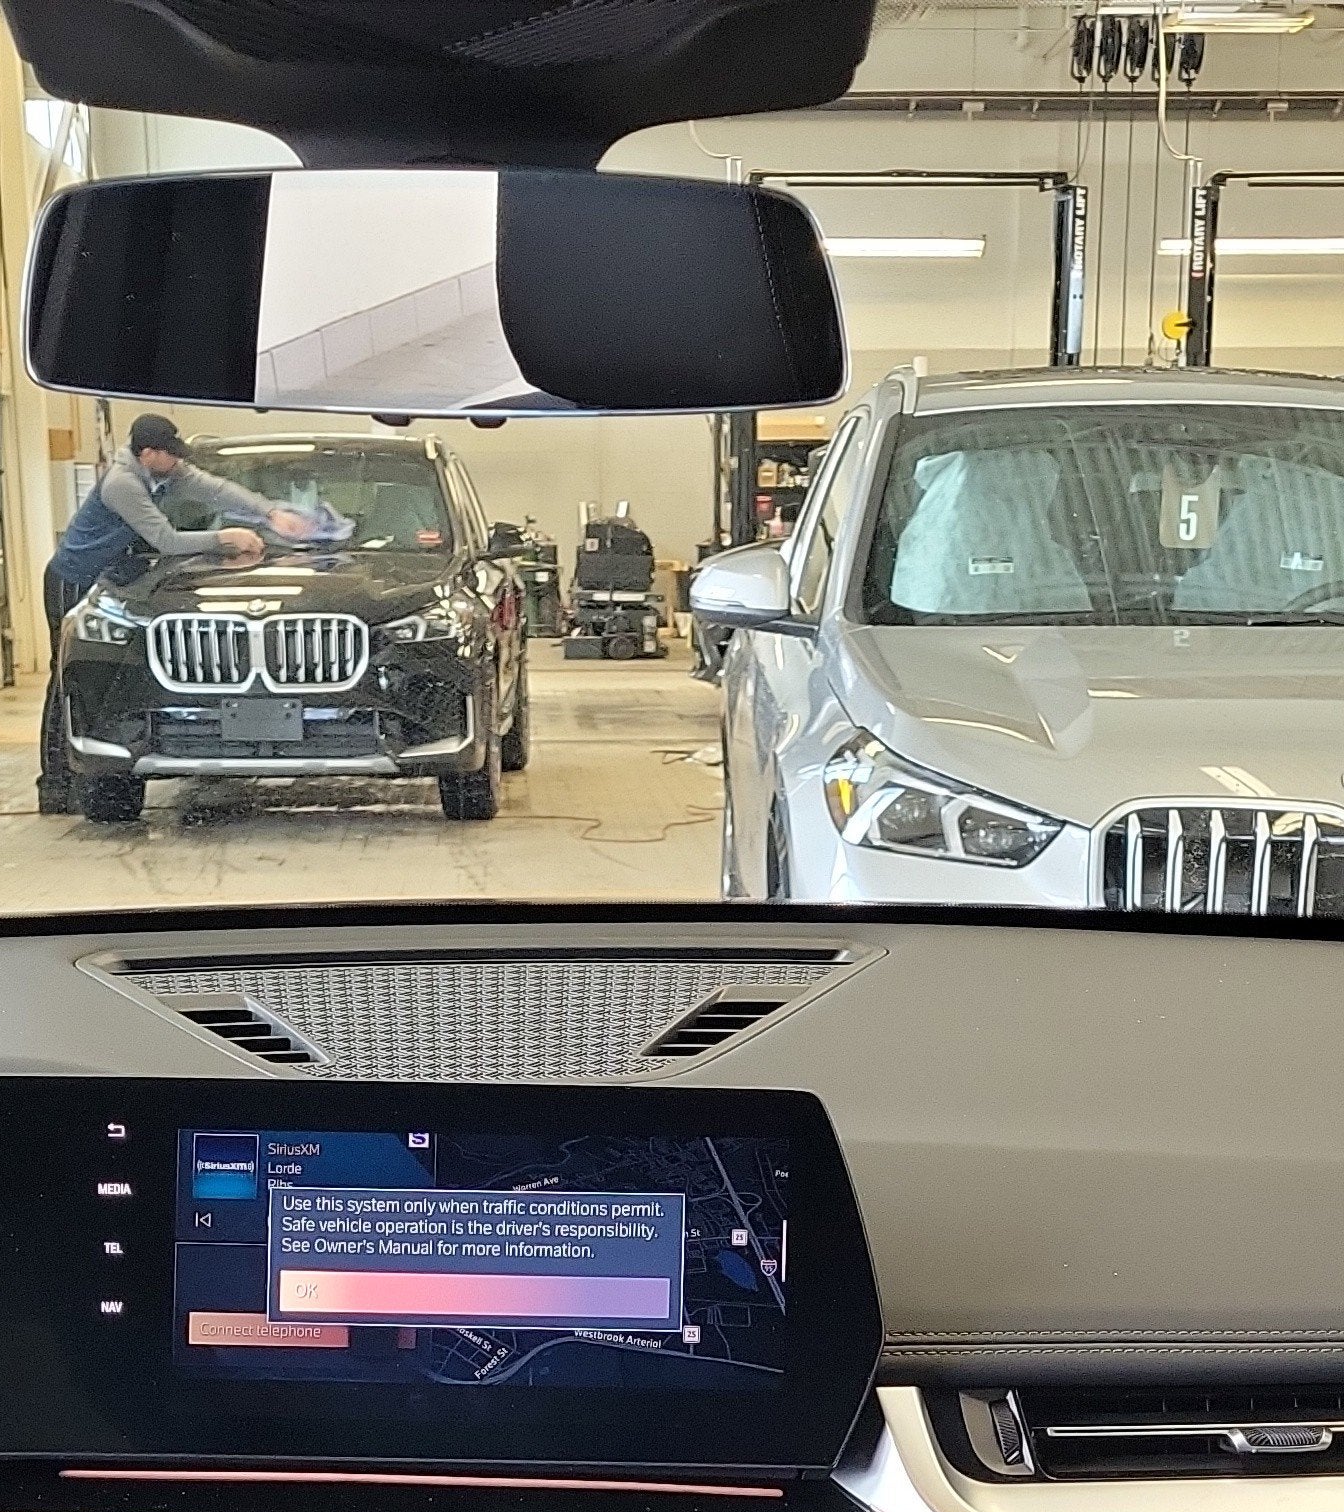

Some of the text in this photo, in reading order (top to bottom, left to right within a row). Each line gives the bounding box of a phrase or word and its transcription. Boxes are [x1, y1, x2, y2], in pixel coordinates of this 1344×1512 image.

[1192, 188, 1207, 271] ROTARY LIFT
[1179, 494, 1199, 541] 5
[267, 1143, 320, 1157] SiriusXM
[267, 1163, 303, 1175] Lorde
[97, 1183, 132, 1194] MEDIA
[543, 1175, 560, 1186] Ave
[283, 1195, 665, 1219] Use this system only when traffic conditions permit.
[281, 1216, 658, 1241] Safe vehicle operation is the driver's responsibility.
[104, 1242, 124, 1253] TEL
[281, 1237, 595, 1259] See Owner's Manual for more information.
[296, 1283, 319, 1299] OK
[101, 1301, 123, 1313] NAV
[200, 1322, 321, 1339] Connect telephone
[573, 1329, 625, 1344] Westbrook
[473, 1346, 509, 1380] Forest St
